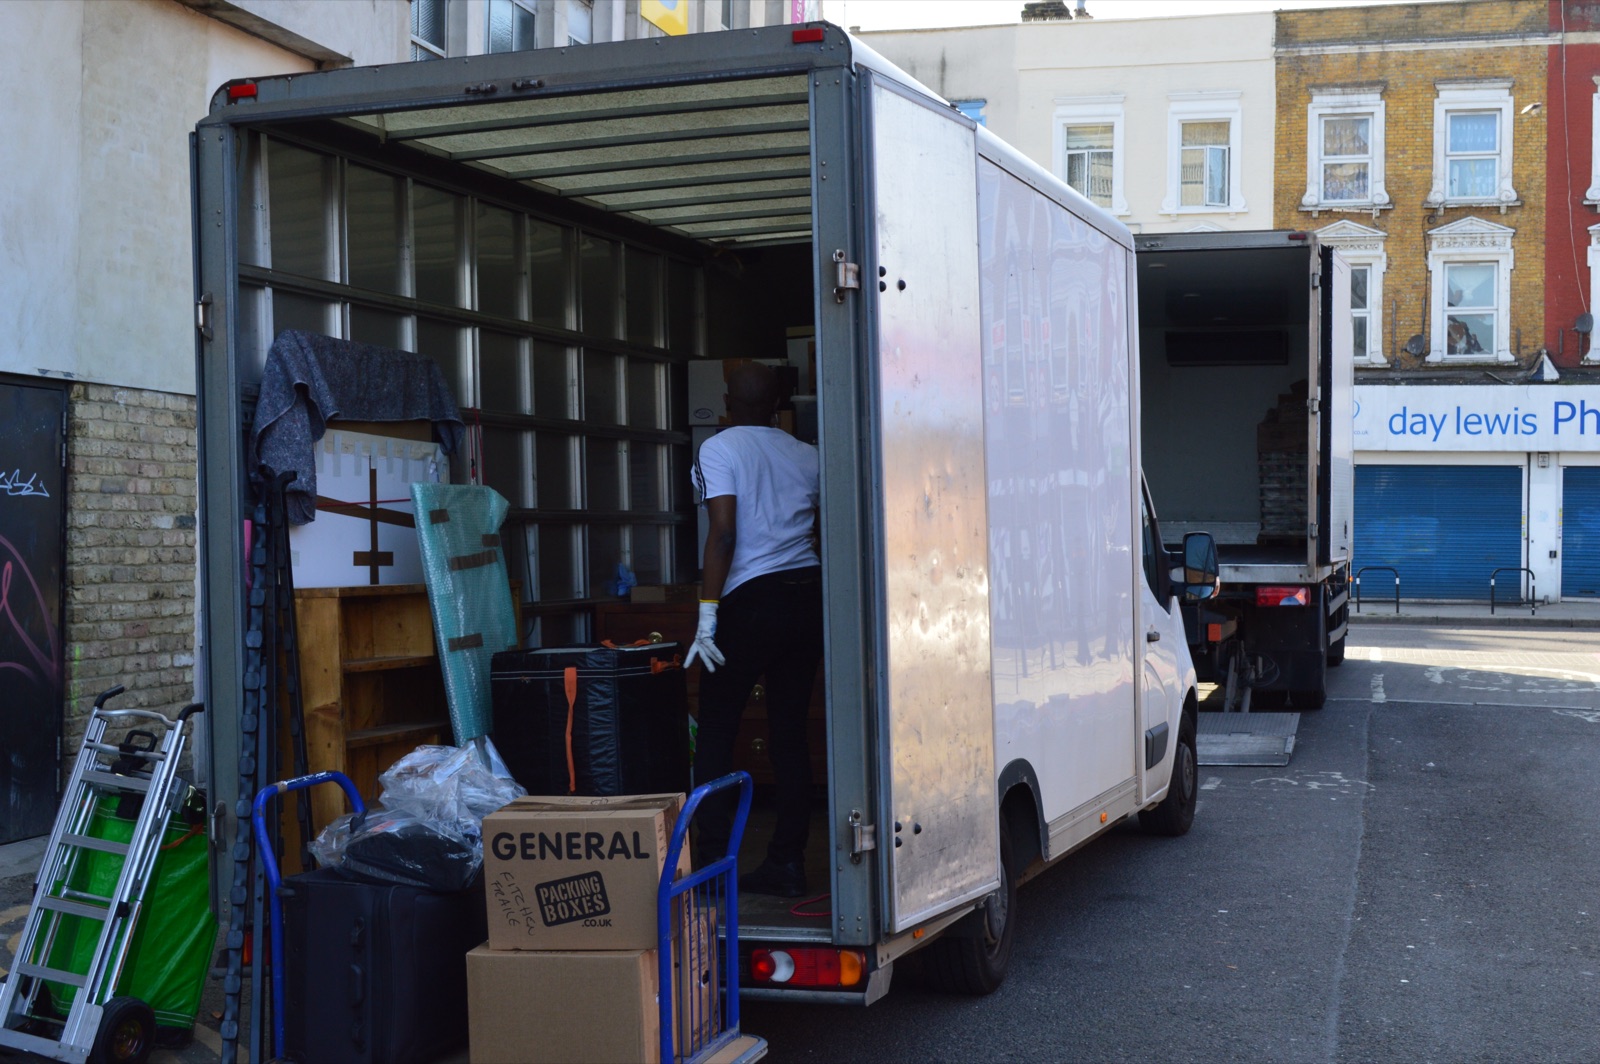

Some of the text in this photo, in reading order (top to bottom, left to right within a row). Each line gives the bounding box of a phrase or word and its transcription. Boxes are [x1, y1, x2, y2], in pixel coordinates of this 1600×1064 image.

[1388, 399, 1600, 442] day lewis Ph
[491, 831, 650, 861] GENERAL
[539, 876, 601, 905] PACKING
[544, 893, 606, 923] BOXES
[582, 919, 612, 927] .CO.UK
